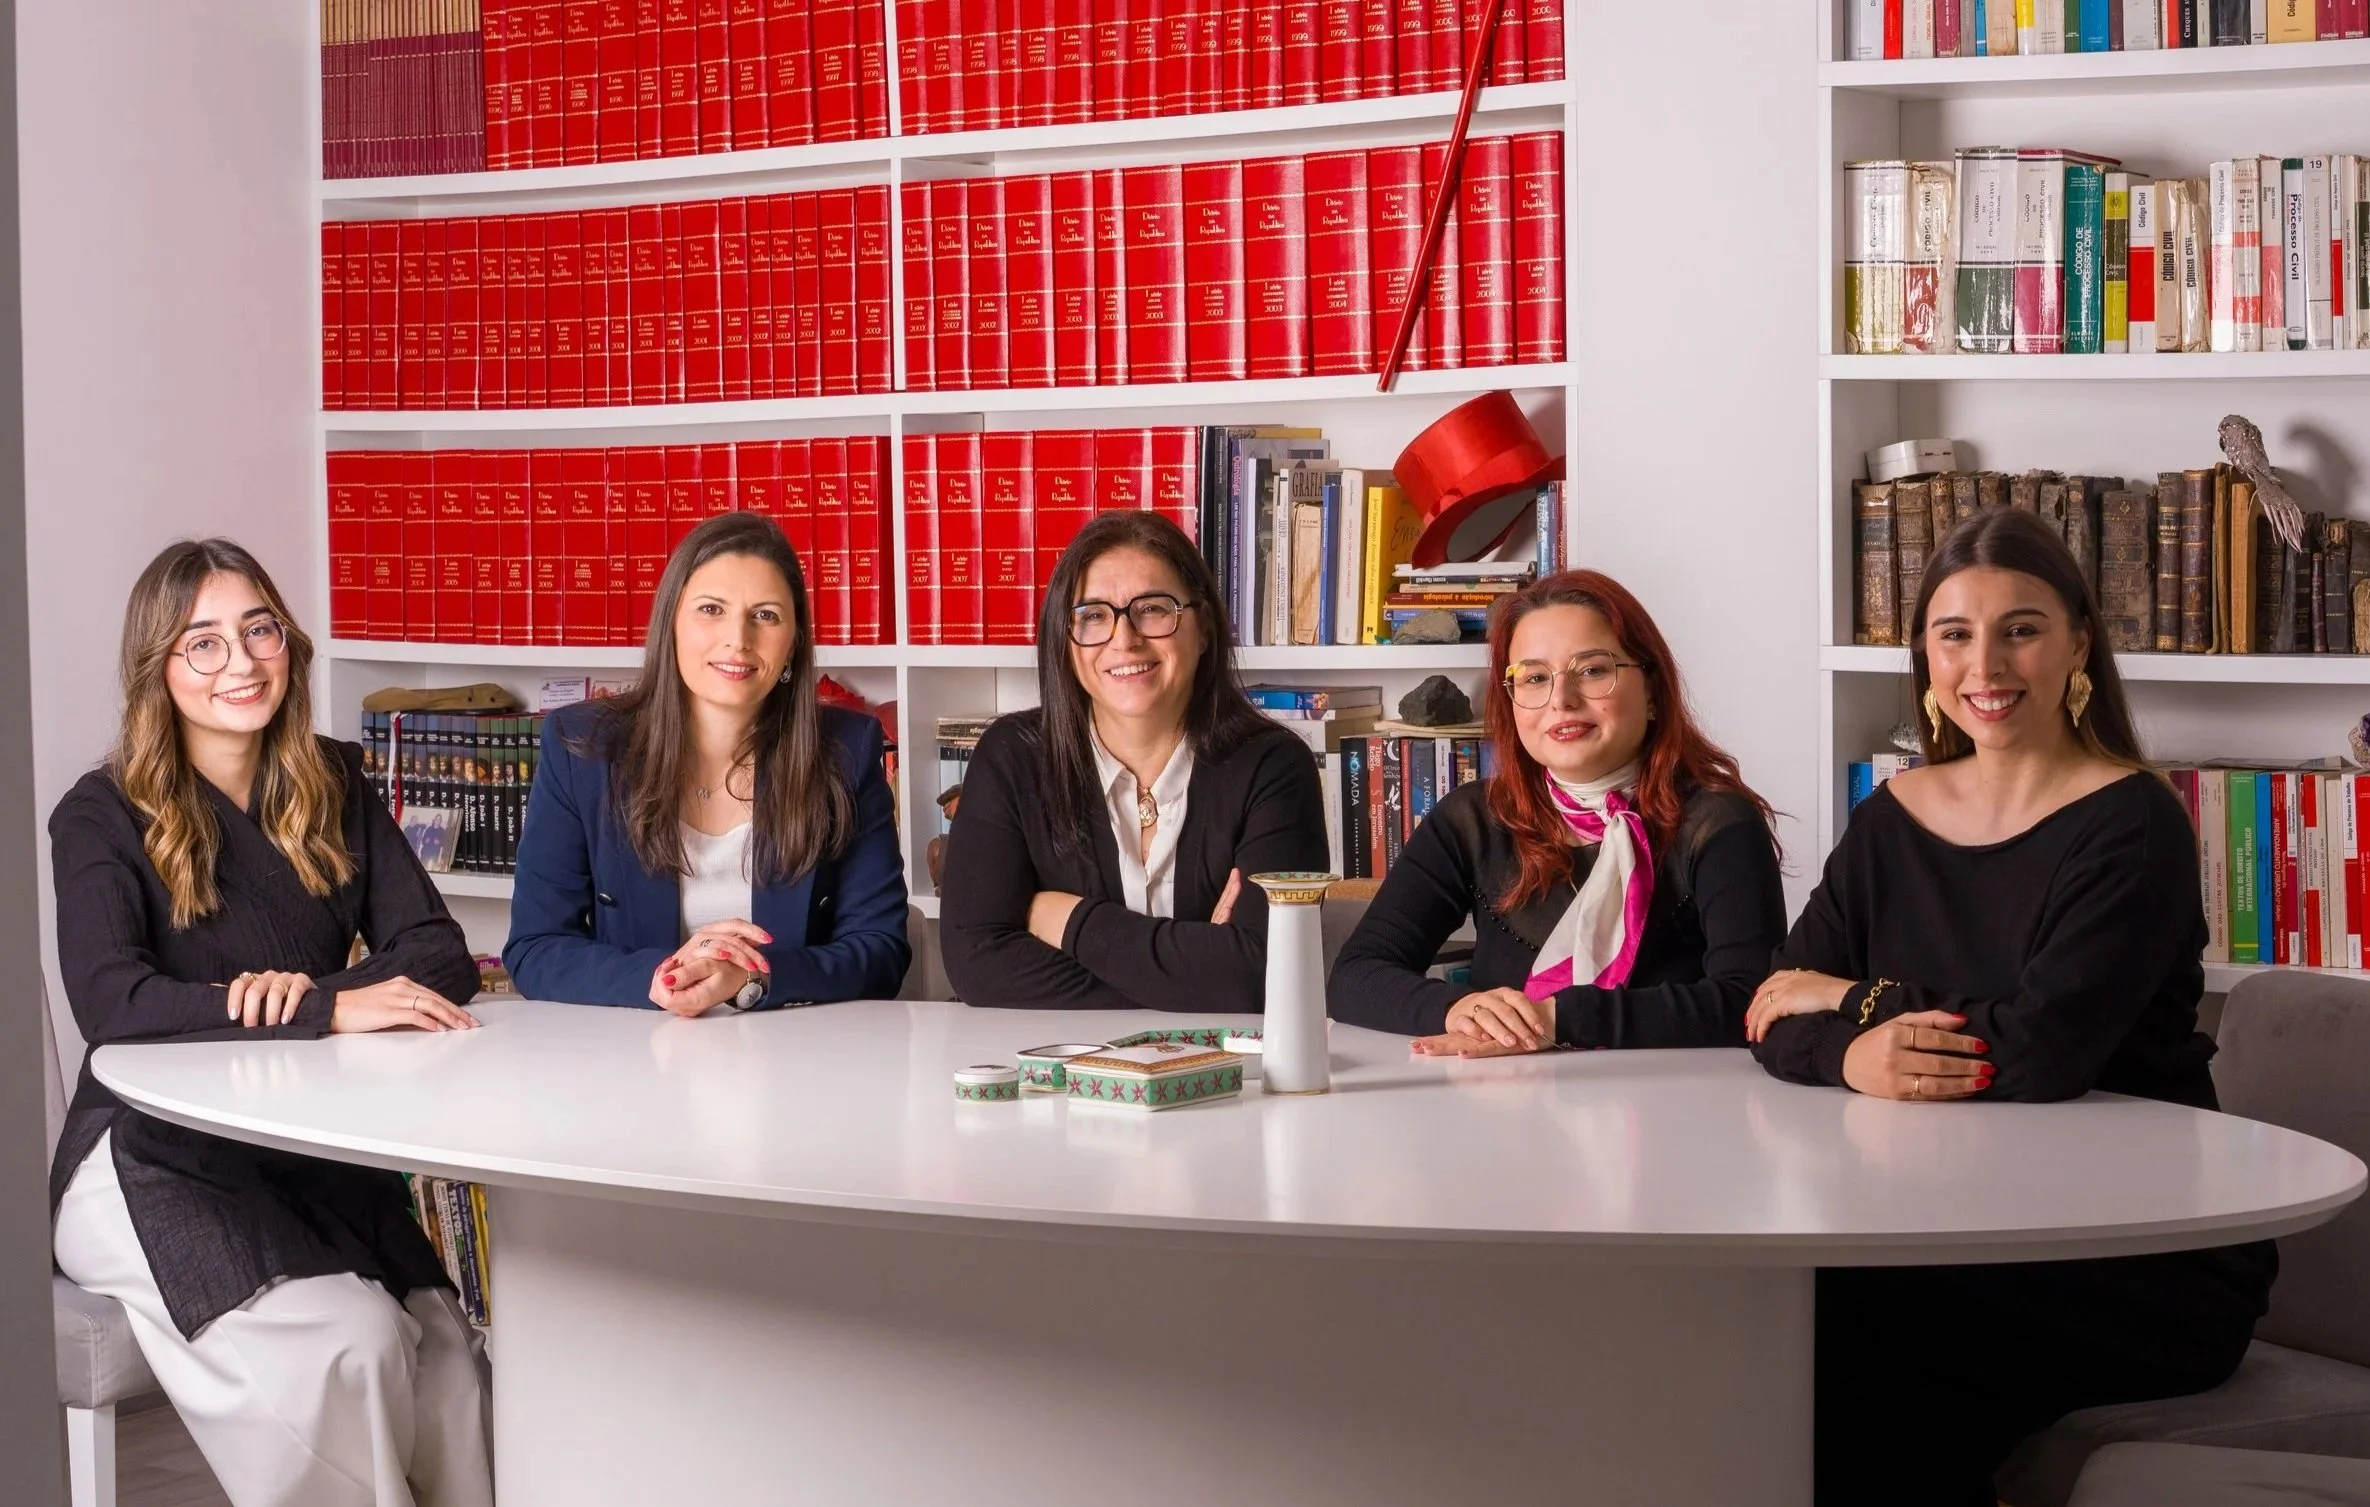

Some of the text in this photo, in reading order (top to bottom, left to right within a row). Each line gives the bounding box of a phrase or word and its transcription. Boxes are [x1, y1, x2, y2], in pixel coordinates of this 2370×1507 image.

[2310, 160, 2322, 169] 19
[2163, 252, 2174, 281] CÓDIGO
[2291, 252, 2299, 280] Civil
[1350, 752, 1360, 806] NÓMADA
